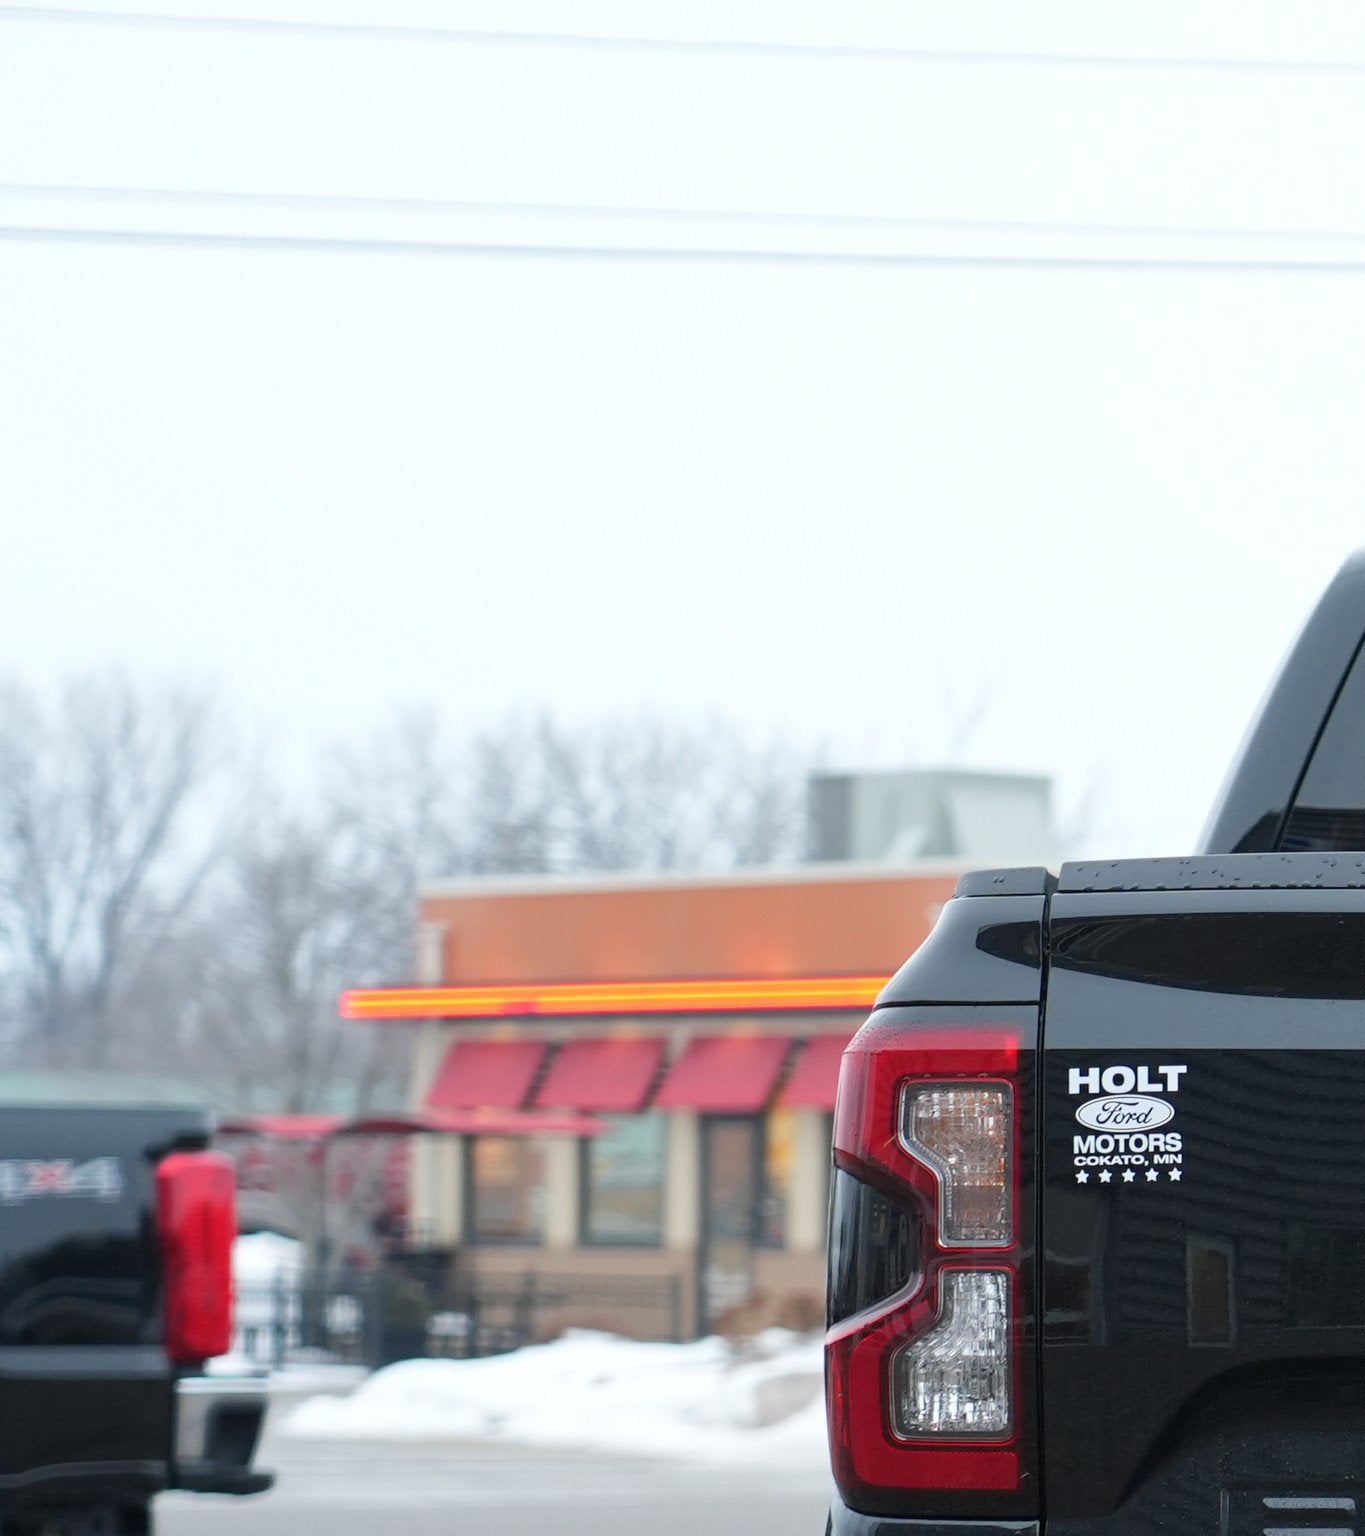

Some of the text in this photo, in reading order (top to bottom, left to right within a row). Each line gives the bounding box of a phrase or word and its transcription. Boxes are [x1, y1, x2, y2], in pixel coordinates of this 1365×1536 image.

[1068, 1065, 1187, 1094] HOLT
[1096, 1101, 1153, 1124] Ford
[1073, 1132, 1182, 1154] MOTORS
[1073, 1153, 1182, 1167] COKATO, MN
